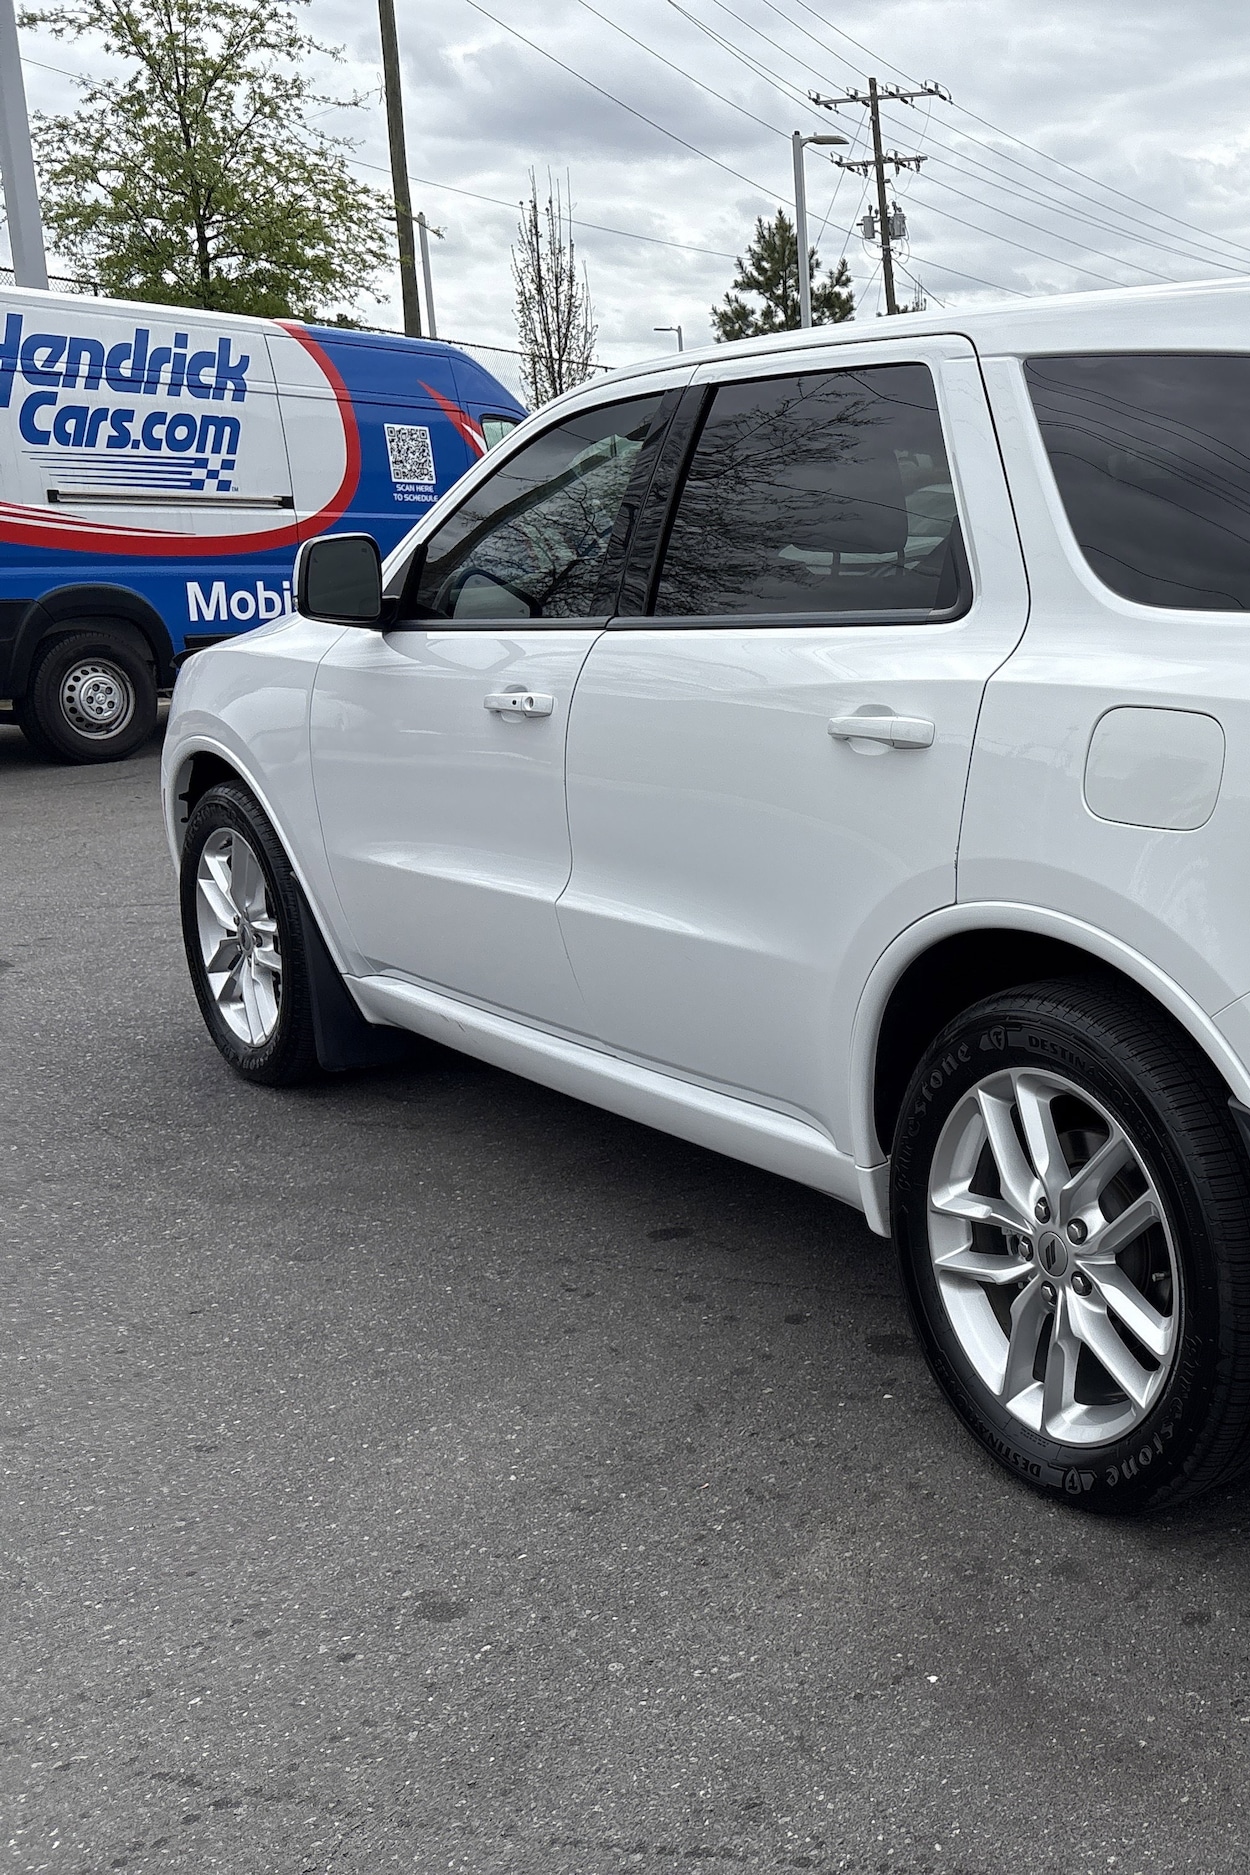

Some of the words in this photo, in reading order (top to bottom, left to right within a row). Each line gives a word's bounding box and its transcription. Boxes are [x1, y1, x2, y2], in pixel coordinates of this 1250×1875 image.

[19, 391, 241, 455] Cars.com
[395, 484, 416, 492] SCAN
[416, 485, 434, 493] HERE
[393, 493, 403, 501] TO
[403, 494, 439, 502] SCHEDULE
